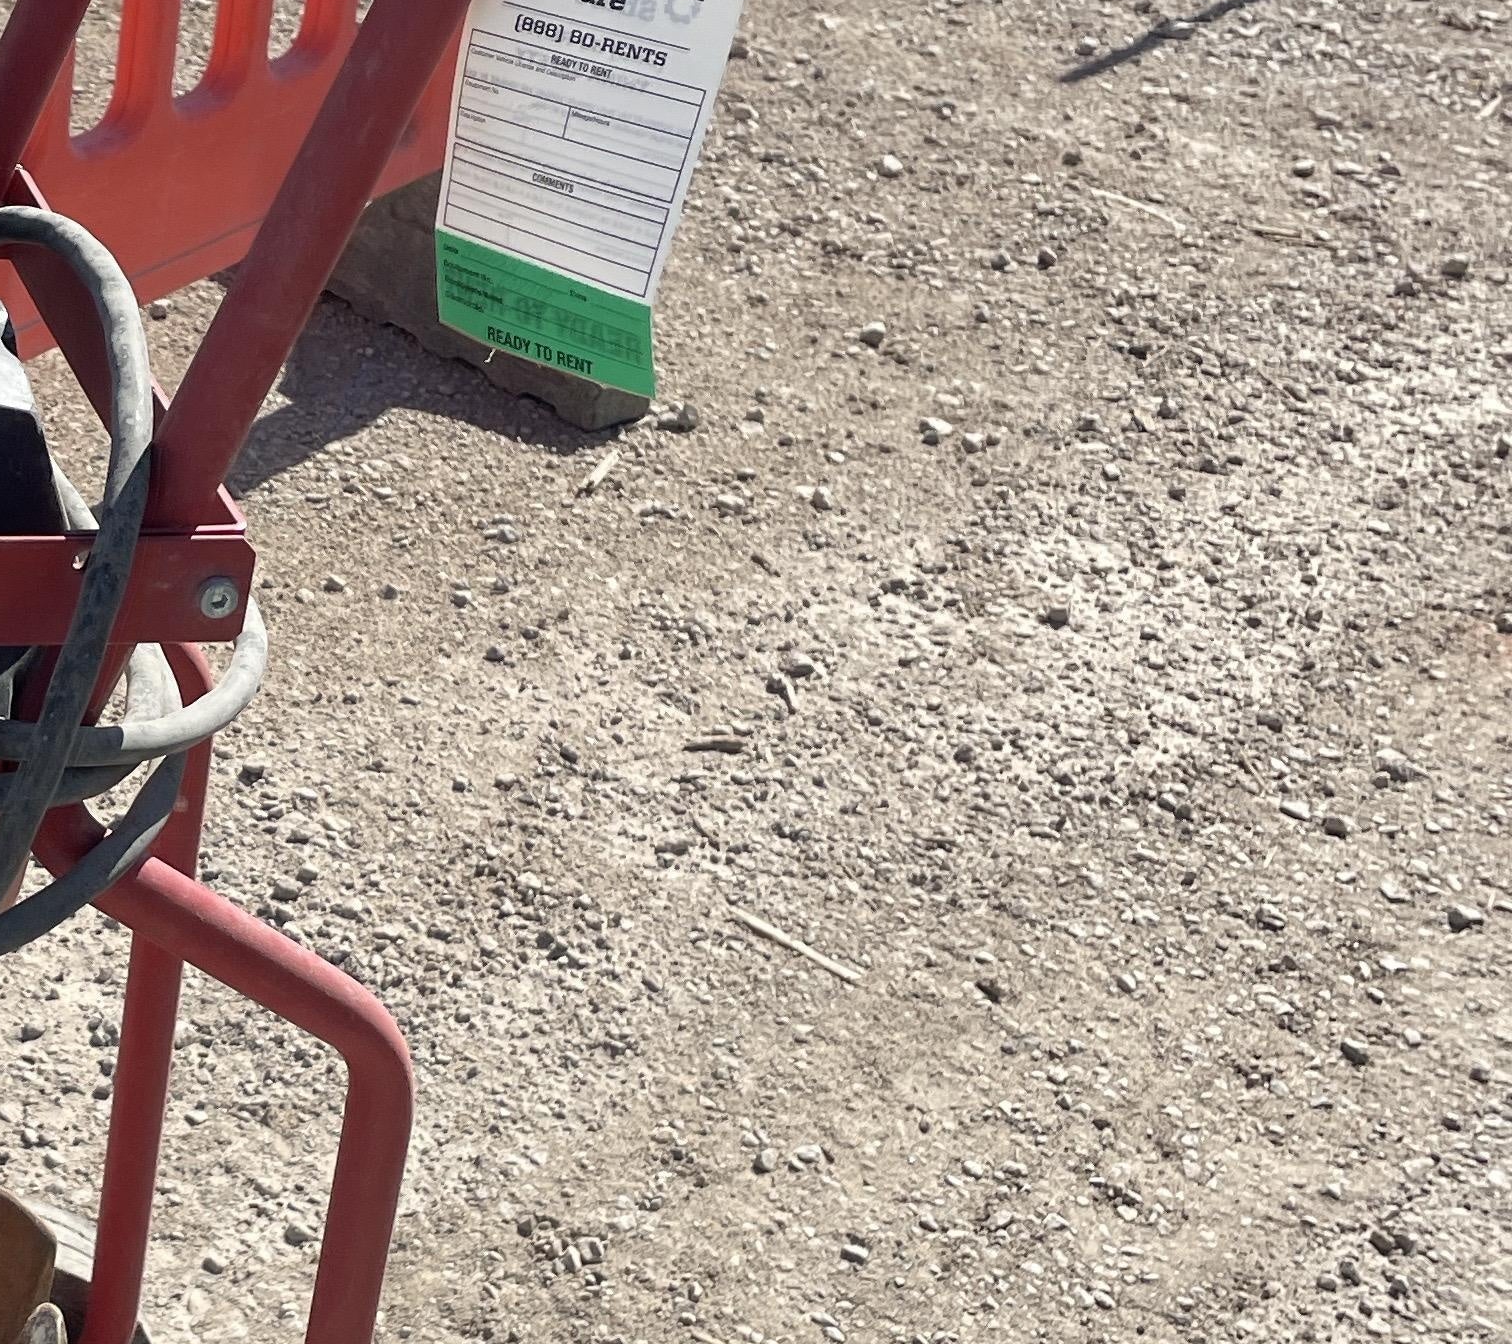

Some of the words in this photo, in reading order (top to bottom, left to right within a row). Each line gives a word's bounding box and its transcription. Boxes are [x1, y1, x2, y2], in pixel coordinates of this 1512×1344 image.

[514, 13, 564, 43] (888)
[569, 29, 668, 67] 80-RENTS
[550, 54, 576, 70] READY
[578, 61, 588, 73] TO
[590, 64, 613, 79] RENT
[532, 172, 574, 194] COMMENTS
[487, 325, 531, 354] READY
[535, 341, 553, 362] TO
[556, 350, 594, 375] RENT
